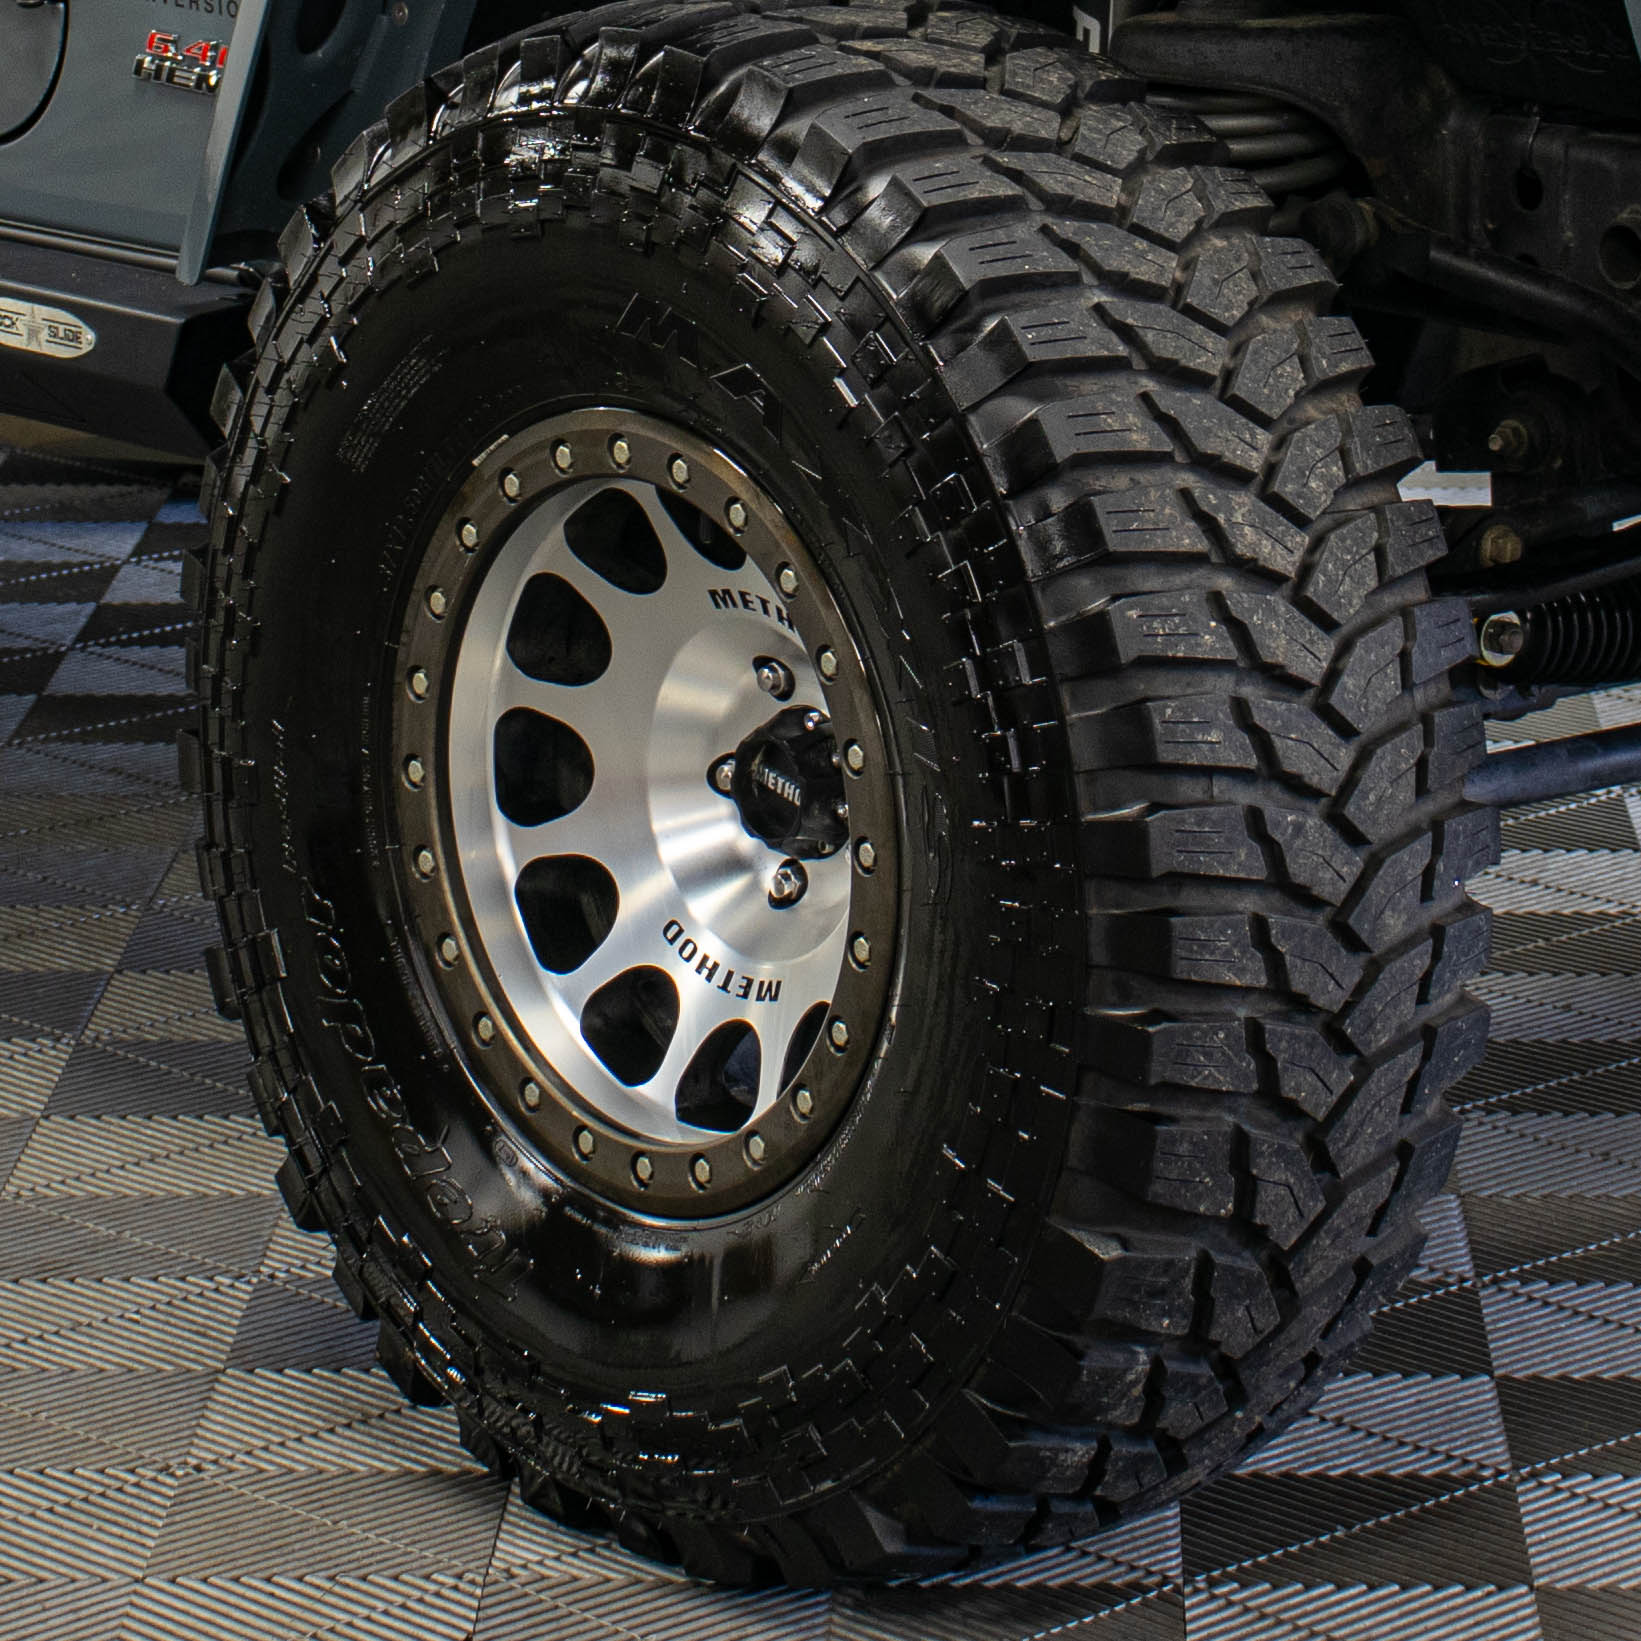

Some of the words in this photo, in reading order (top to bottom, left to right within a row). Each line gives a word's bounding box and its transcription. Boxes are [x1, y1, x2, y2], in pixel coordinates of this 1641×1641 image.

[132, 53, 221, 95] HEM
[47, 323, 83, 345] SLIDE
[707, 587, 795, 634] METH
[662, 918, 783, 1003] METHOD
